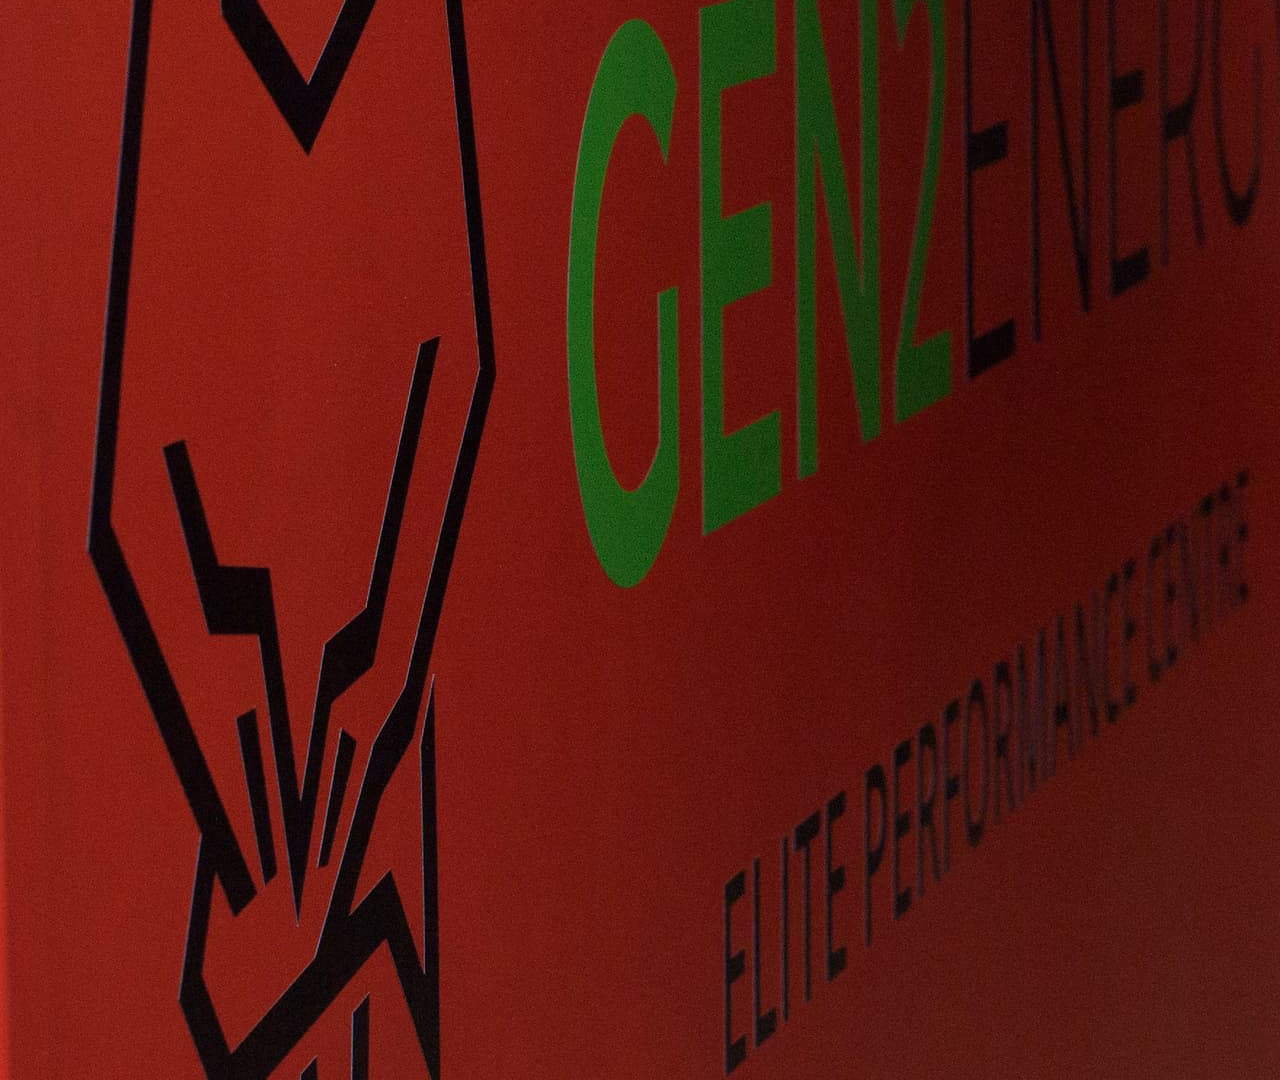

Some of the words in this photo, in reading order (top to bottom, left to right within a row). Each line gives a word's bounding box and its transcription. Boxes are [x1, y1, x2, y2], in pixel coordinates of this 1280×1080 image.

[723, 790, 847, 1076] ELITE
[864, 557, 1137, 948] PERFORMANCE
[1145, 467, 1251, 684] CENTRE
